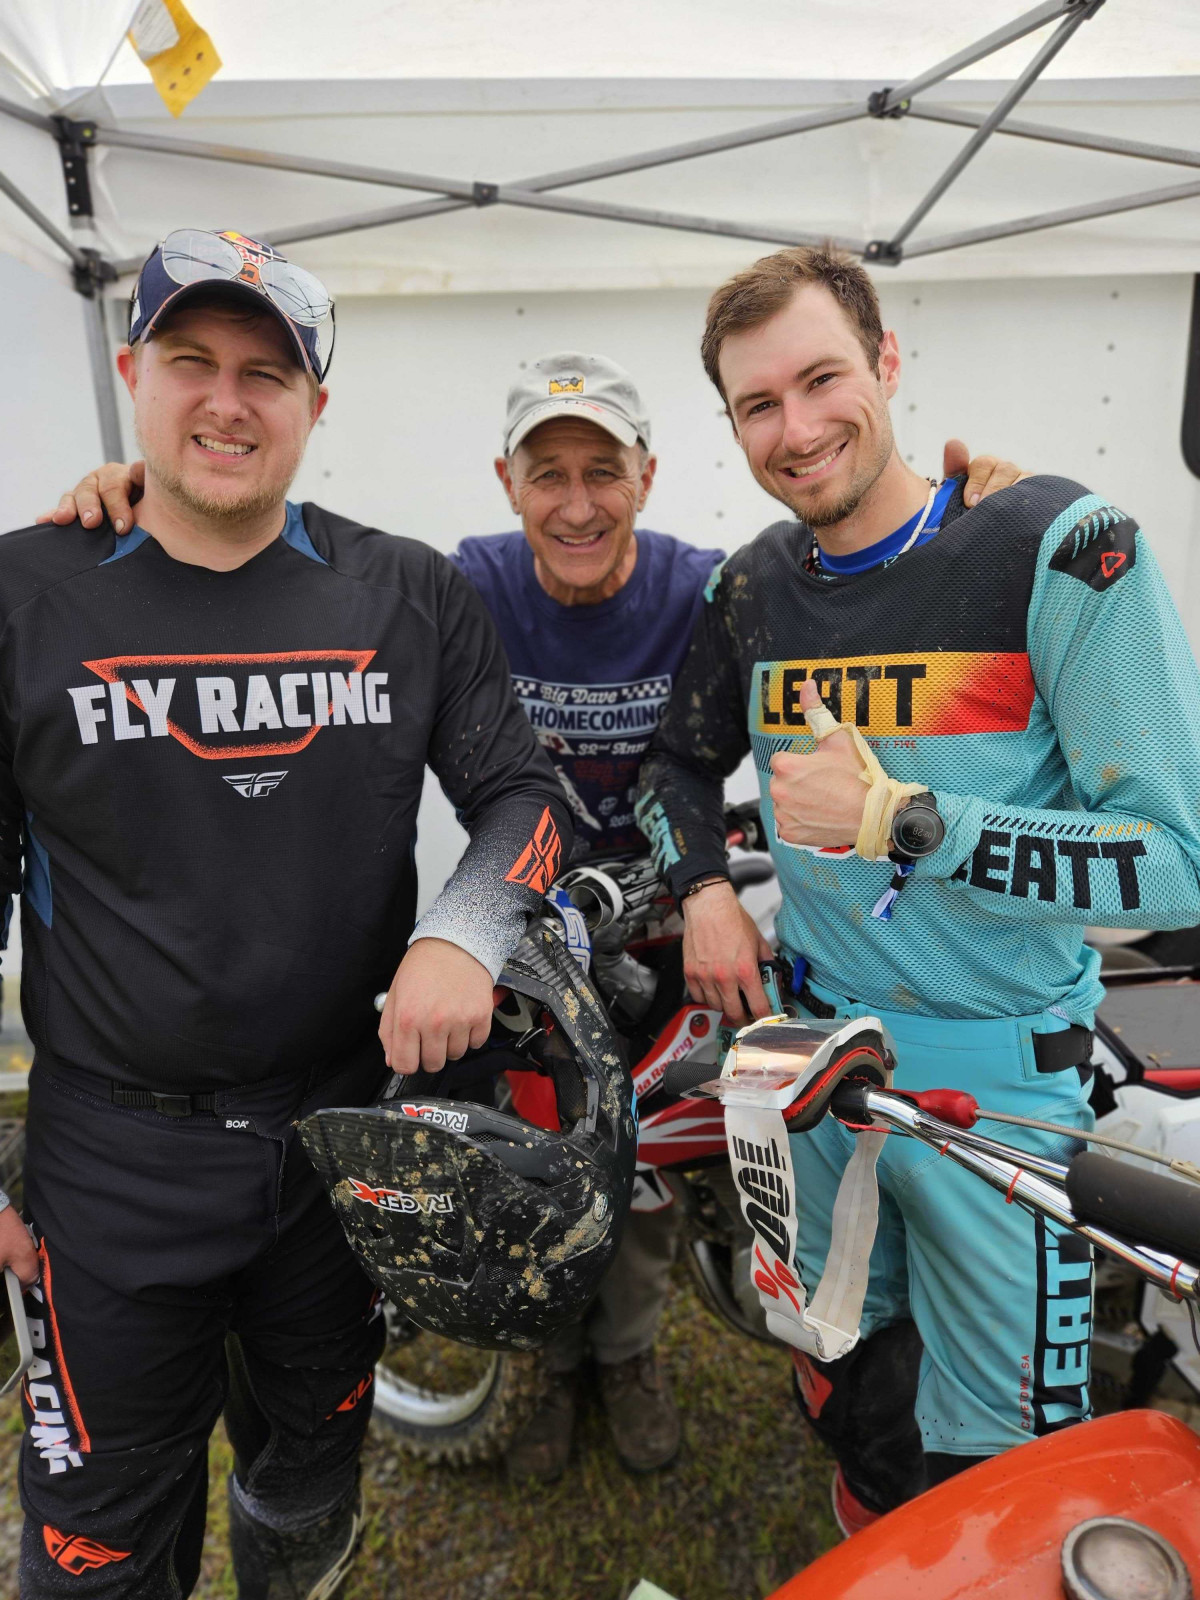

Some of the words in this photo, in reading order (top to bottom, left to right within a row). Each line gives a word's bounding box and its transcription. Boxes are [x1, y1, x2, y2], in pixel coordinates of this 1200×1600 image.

[540, 685, 569, 707] Big
[571, 688, 618, 704] Dave
[761, 663, 927, 727] LEATT
[66, 677, 176, 745] FLY
[195, 671, 392, 734] RACING
[612, 741, 649, 757] Ann
[893, 739, 917, 748] FIVE
